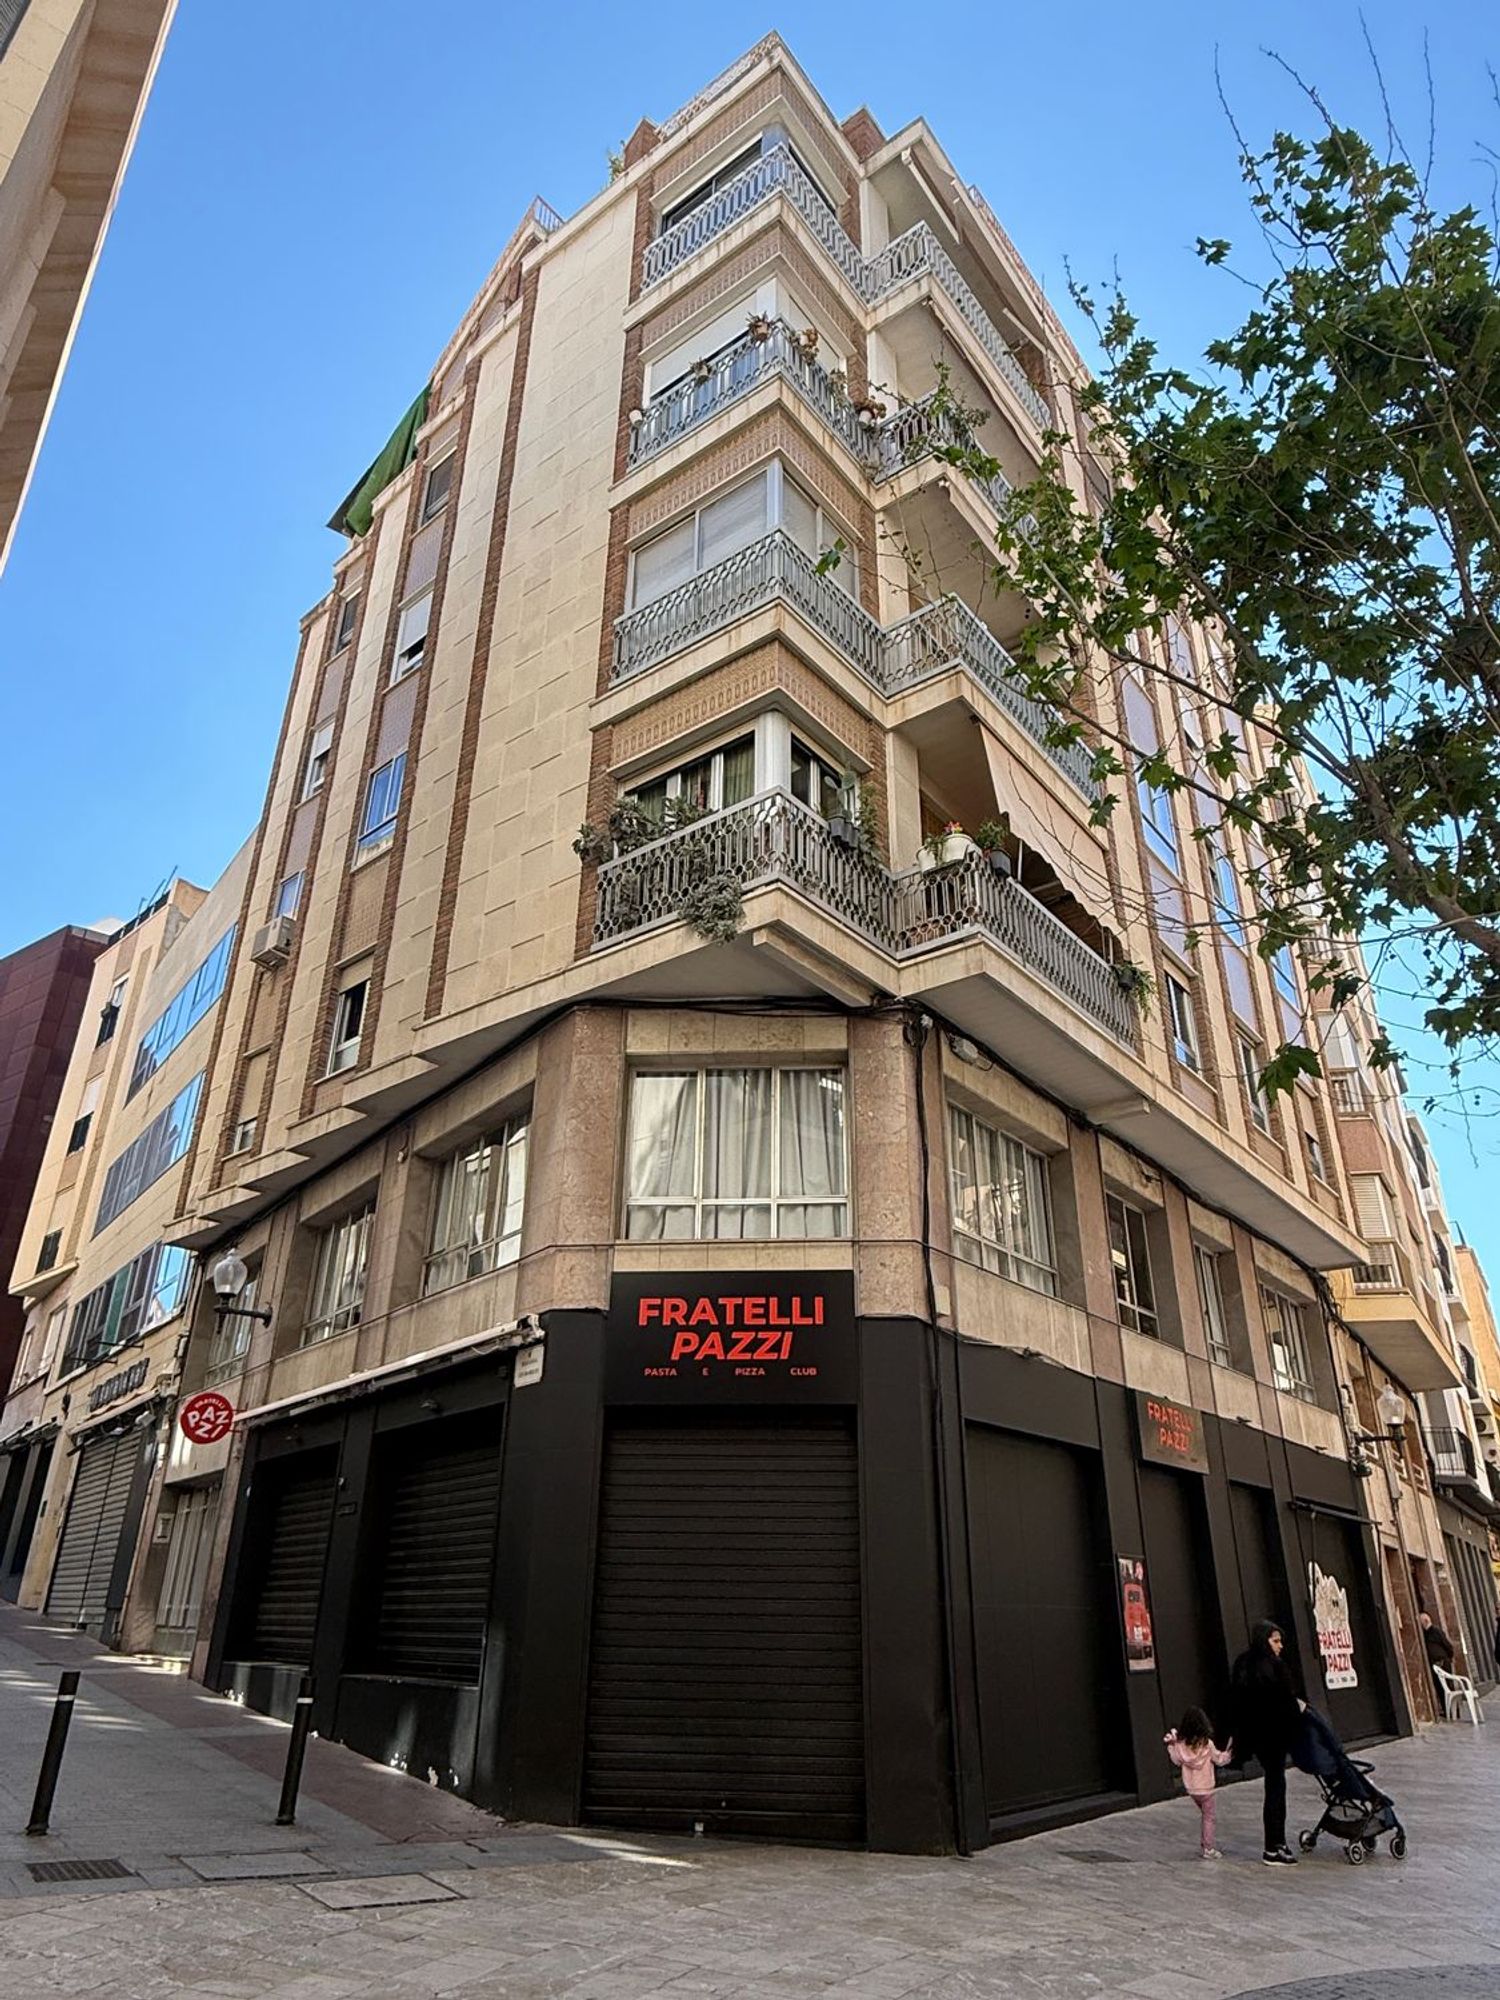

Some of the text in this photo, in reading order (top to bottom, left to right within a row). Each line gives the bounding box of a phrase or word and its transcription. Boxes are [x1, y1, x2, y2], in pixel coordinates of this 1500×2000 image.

[638, 1296, 824, 1326] FRATELLI
[670, 1331, 793, 1361] PAZZI
[644, 1366, 818, 1377] PASTA E PIZZA CLUB
[1147, 1401, 1195, 1432] FRATELLI
[1317, 1630, 1352, 1649] FRATELLI
[1327, 1653, 1351, 1672] PAZZI
